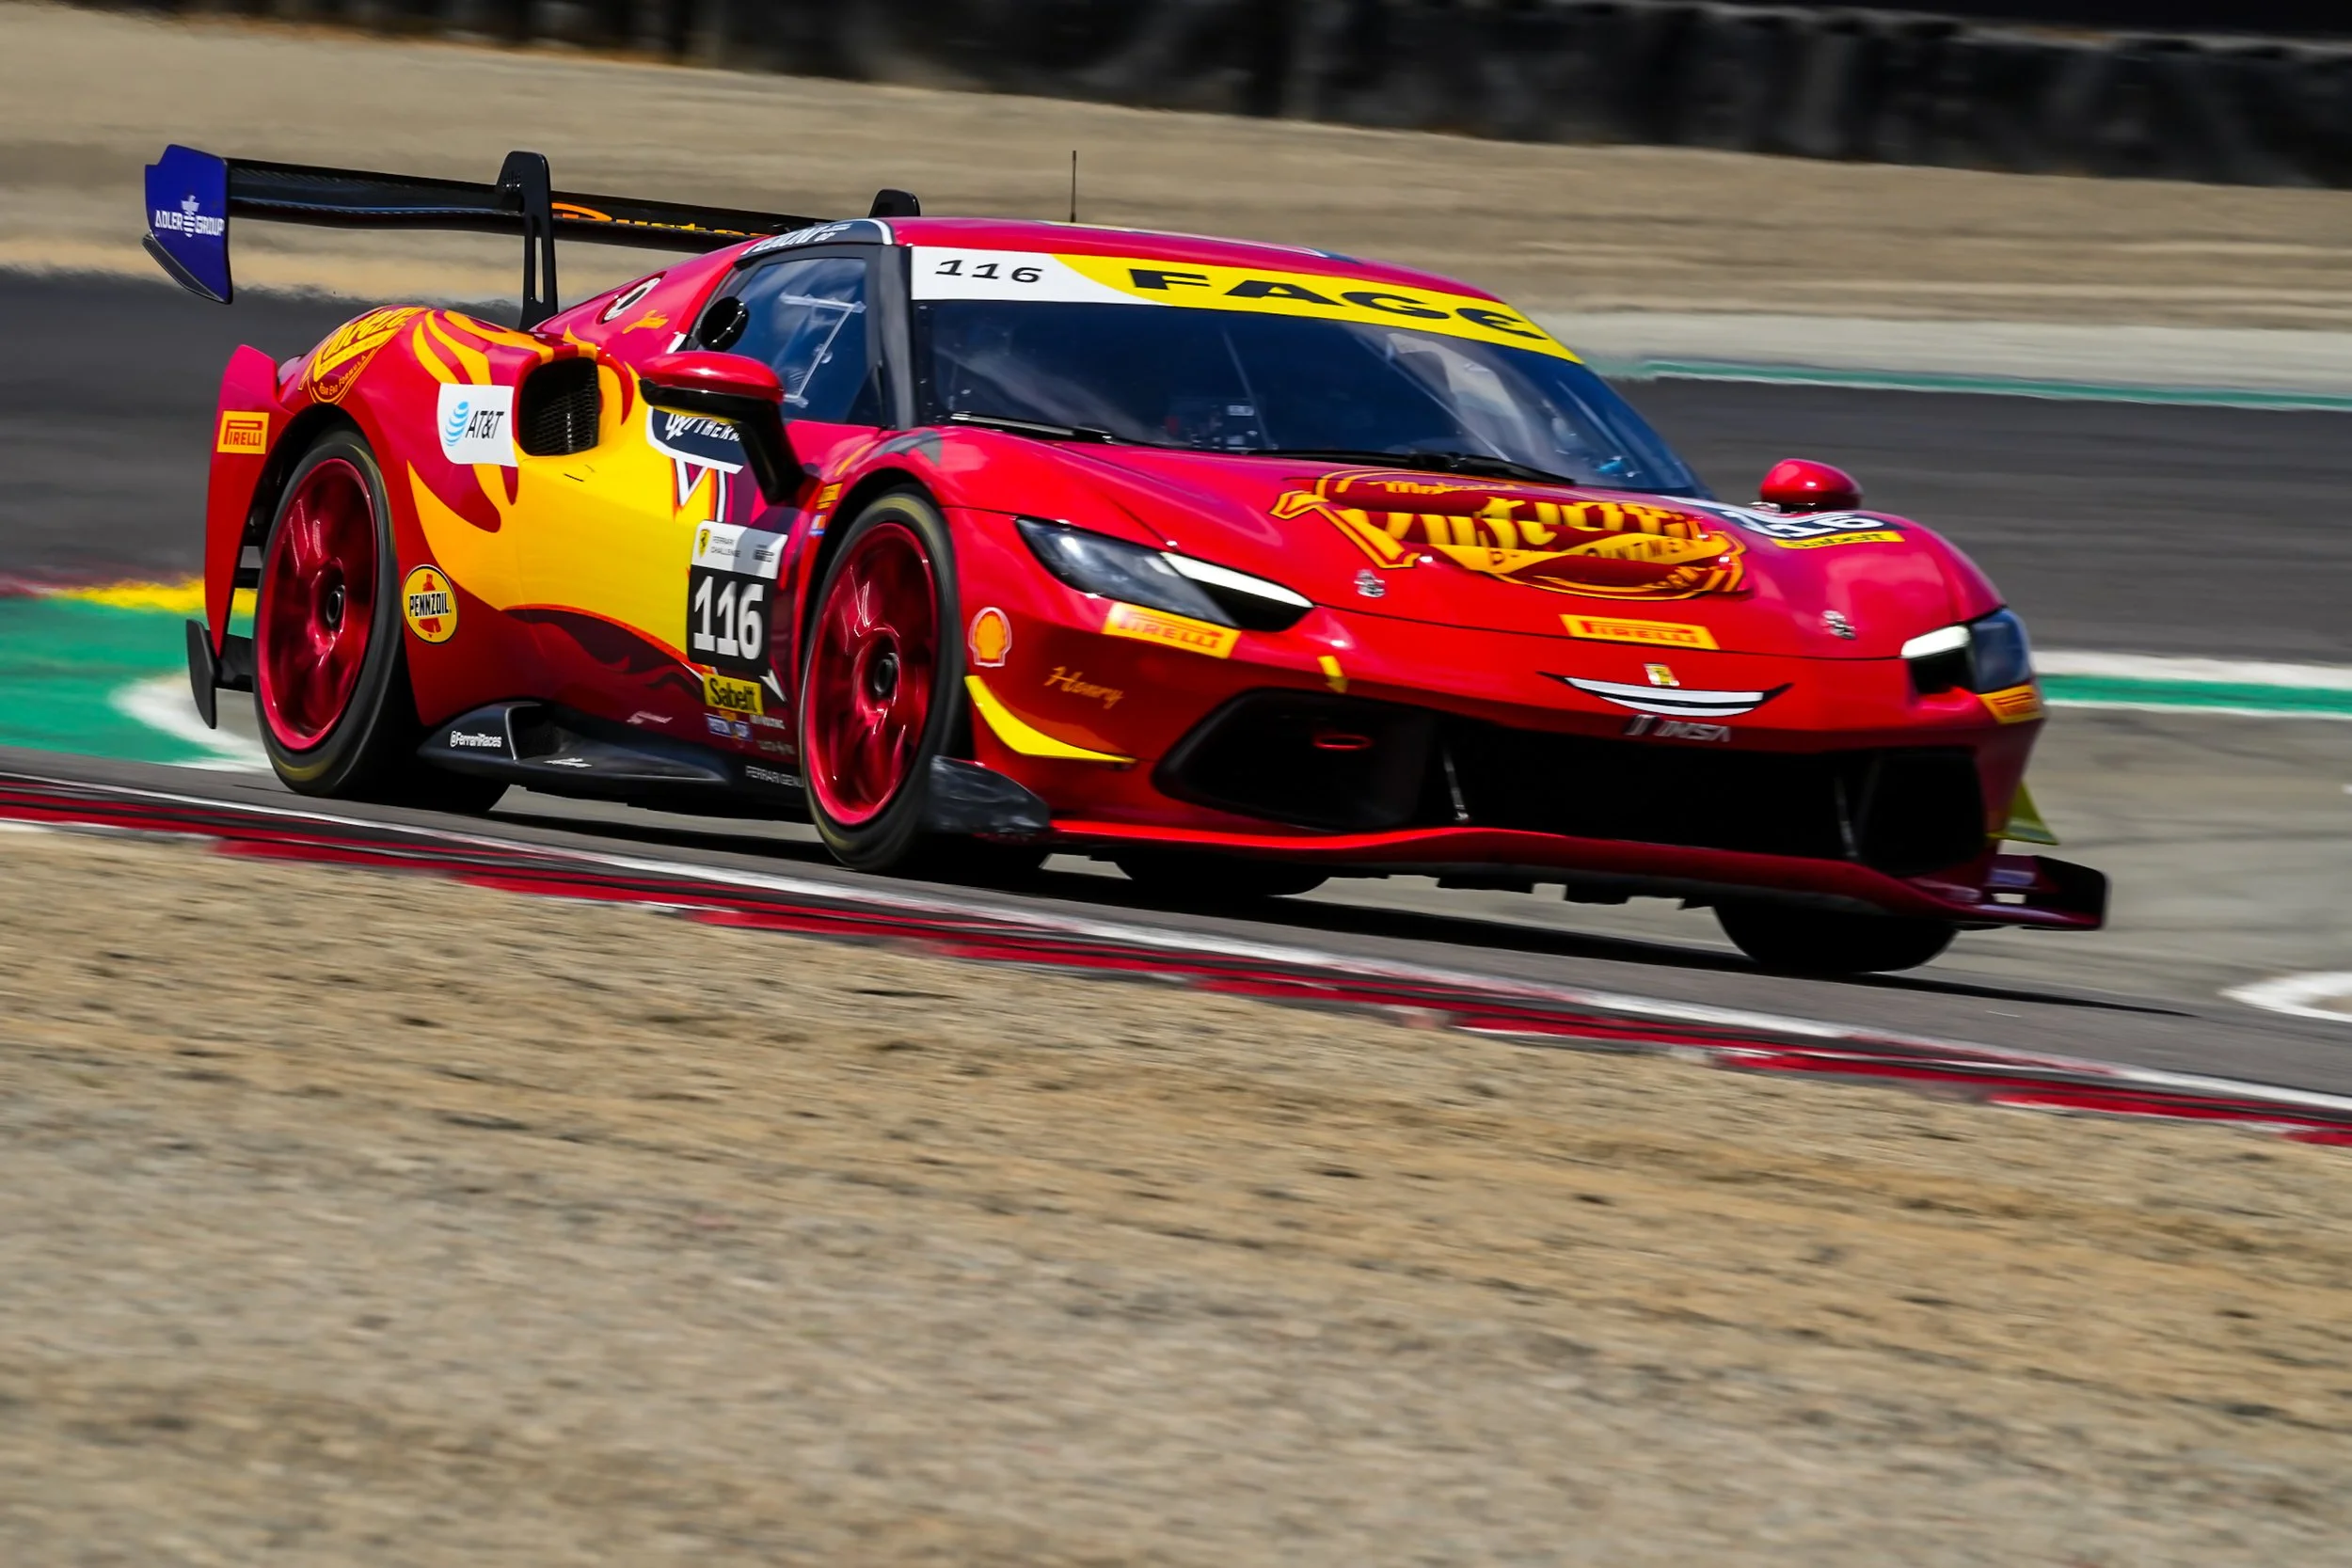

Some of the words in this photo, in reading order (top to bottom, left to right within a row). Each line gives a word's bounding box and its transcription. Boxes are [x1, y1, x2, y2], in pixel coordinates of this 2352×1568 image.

[155, 210, 183, 230] ADLER
[196, 214, 226, 236] GROUP
[935, 260, 1043, 283] 116
[1128, 269, 1549, 340] FAGE
[223, 420, 263, 447] PIRELLI
[465, 410, 505, 439] AT&T
[408, 593, 450, 617] PENNZOIL
[693, 575, 764, 659] 116
[1116, 611, 1224, 649] PIRELLI
[1579, 620, 1700, 643] PIRELLI
[450, 730, 501, 747] @FerrariRaces
